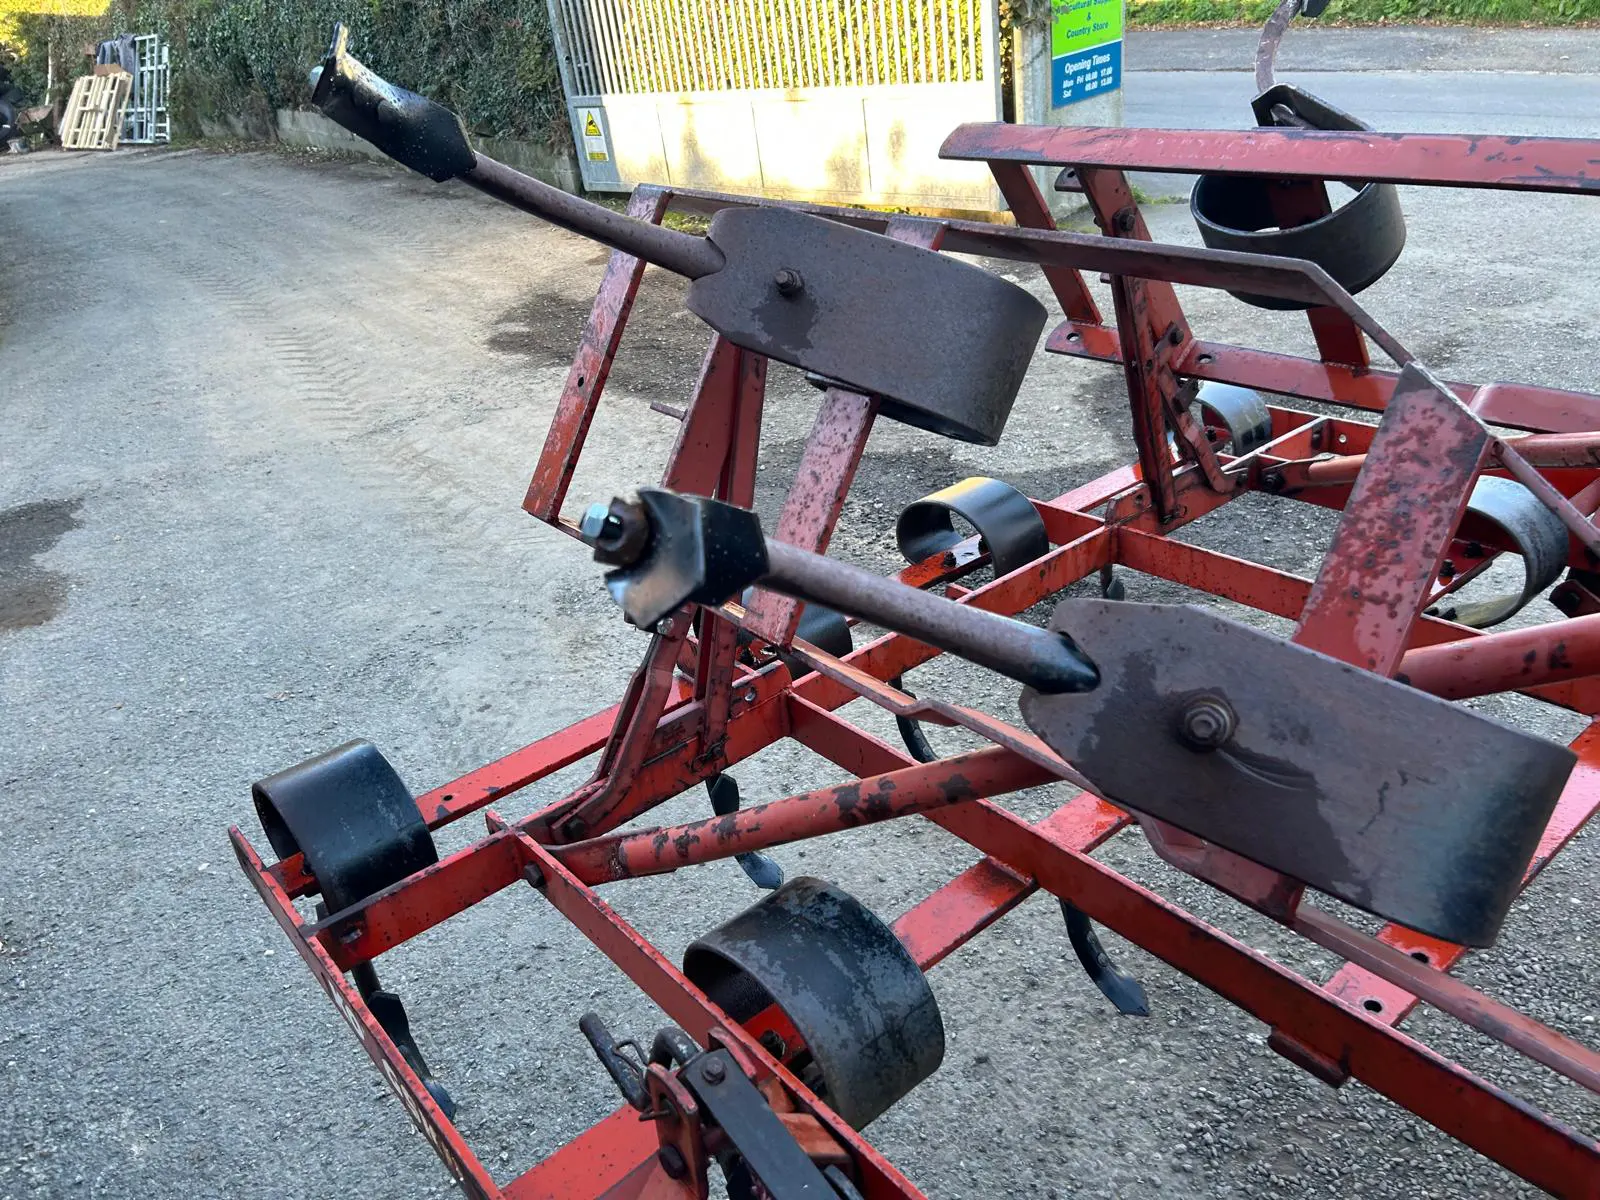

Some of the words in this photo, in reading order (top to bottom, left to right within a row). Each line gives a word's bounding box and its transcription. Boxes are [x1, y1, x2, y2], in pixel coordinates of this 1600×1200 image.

[1067, 28, 1091, 39] Country
[1093, 22, 1109, 32] Store
[1065, 59, 1092, 75] Opening
[1093, 54, 1111, 66] Times
[1063, 80, 1074, 89] Mon
[1076, 75, 1085, 84] Fri
[1063, 90, 1072, 98] Sat
